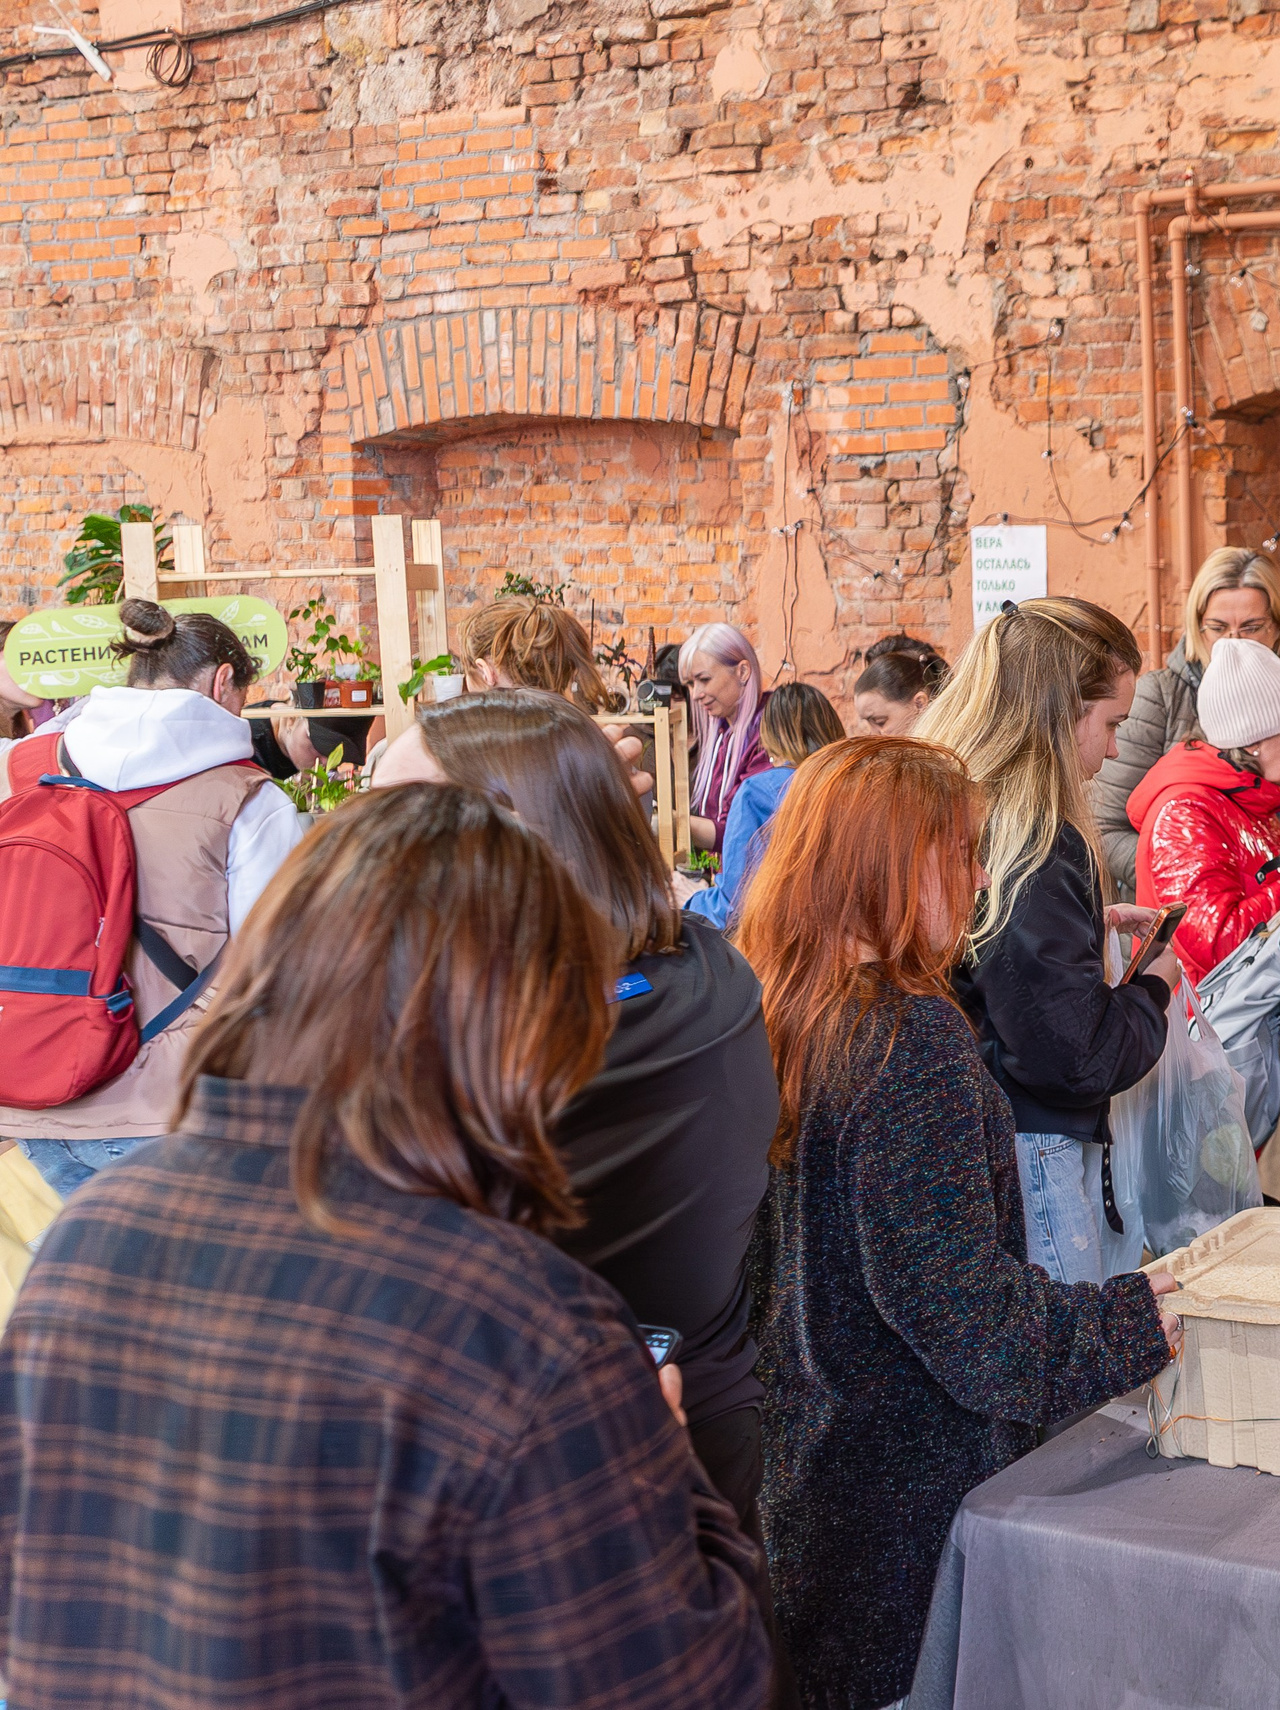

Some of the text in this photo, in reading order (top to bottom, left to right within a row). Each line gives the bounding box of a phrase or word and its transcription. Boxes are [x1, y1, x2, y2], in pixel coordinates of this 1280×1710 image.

[975, 537, 1003, 549] ВЕРА
[976, 558, 1031, 571] ОСТАЛАСЬ
[976, 579, 1016, 592] ТОЛЬКО
[975, 601, 1003, 613] У АЛ
[19, 646, 112, 666] РАСТЕНИ
